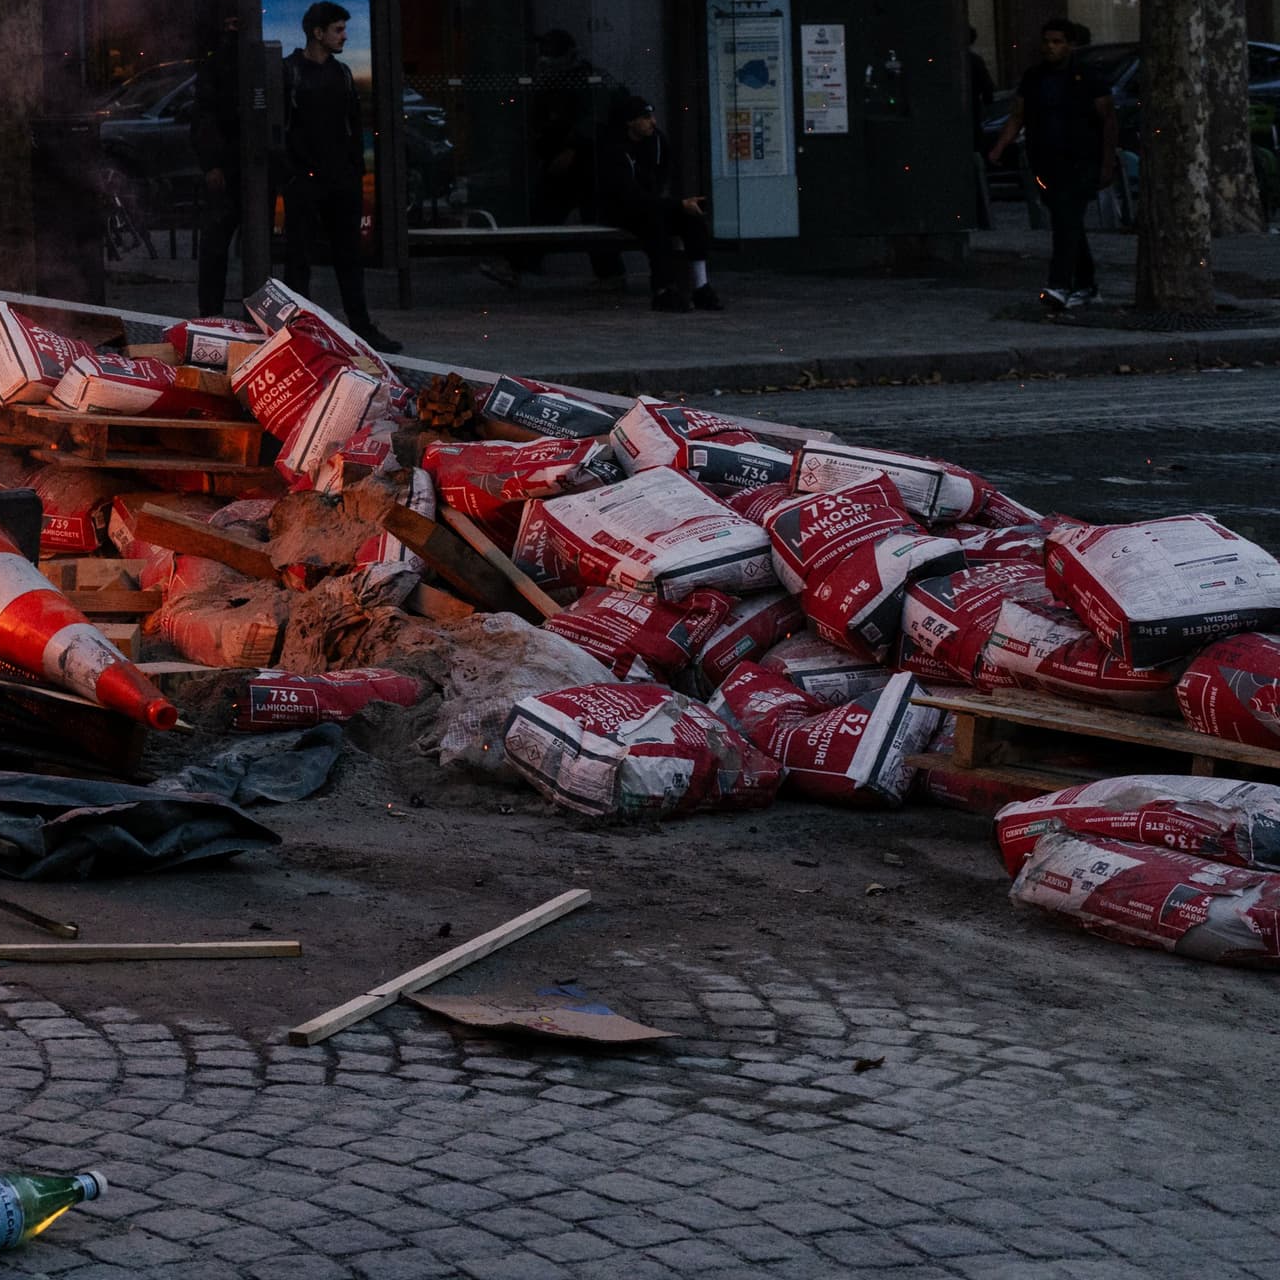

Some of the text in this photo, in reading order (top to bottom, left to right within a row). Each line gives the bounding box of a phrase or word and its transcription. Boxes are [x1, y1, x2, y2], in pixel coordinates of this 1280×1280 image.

[248, 368, 276, 398] 736
[252, 368, 305, 418] ANKOCRETE
[541, 408, 560, 423] 52
[741, 465, 769, 482] 736
[804, 495, 853, 519] 736
[50, 519, 70, 530] 739
[823, 513, 872, 539] RÉSEAUX
[839, 579, 871, 613] 25 kg
[269, 689, 299, 703] 736
[256, 703, 314, 714] LANKOCRETE
[839, 712, 870, 737] 52
